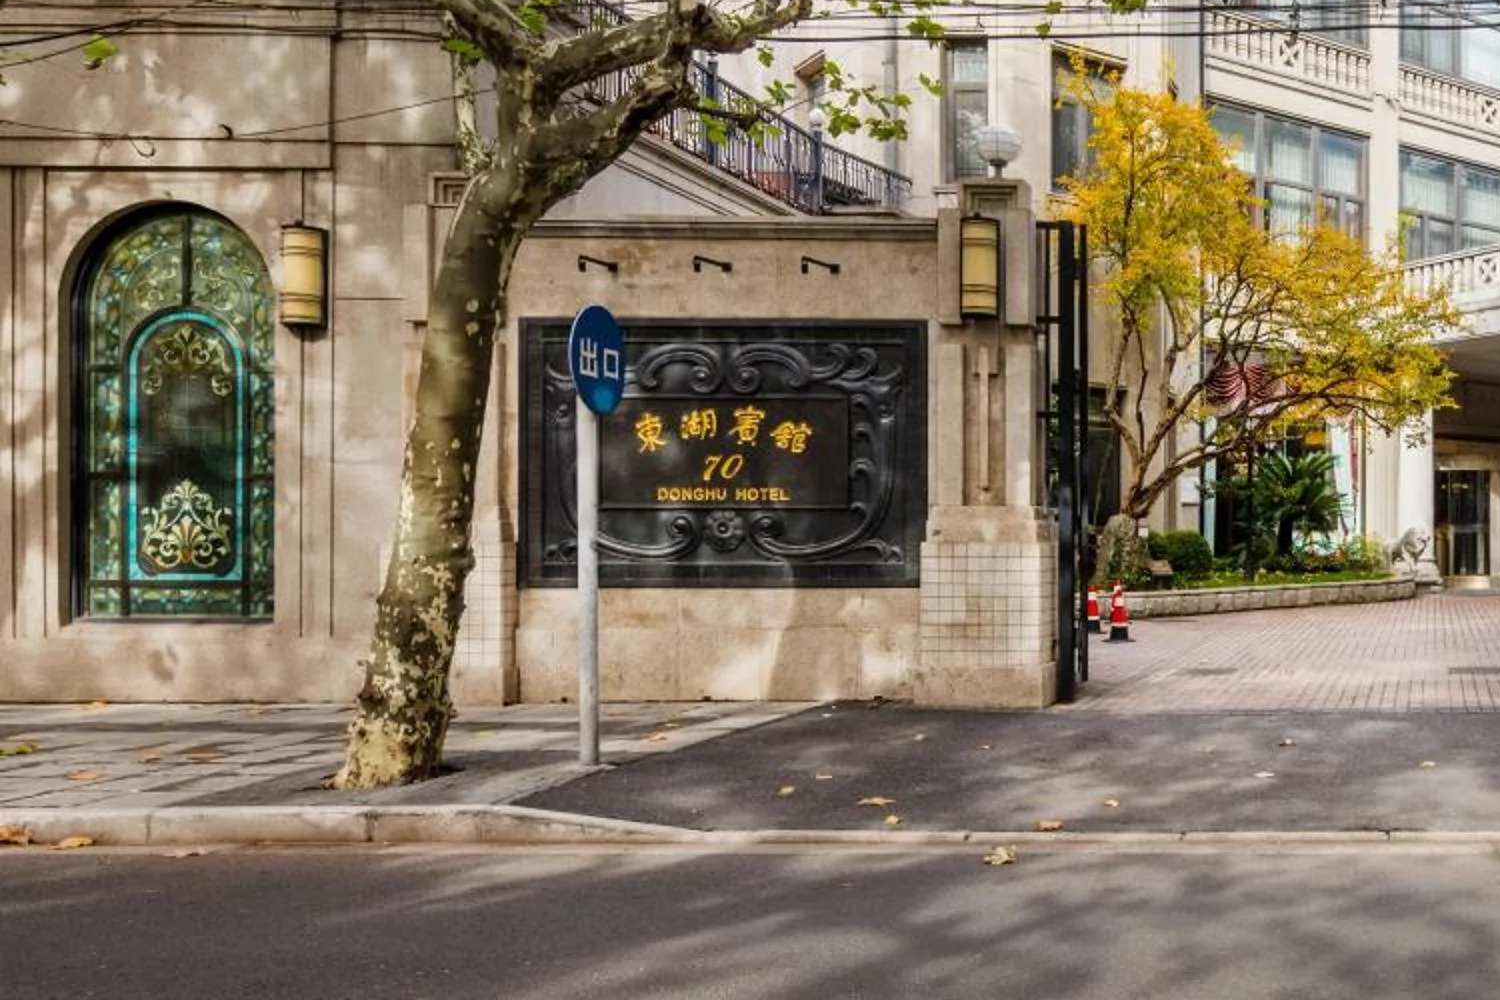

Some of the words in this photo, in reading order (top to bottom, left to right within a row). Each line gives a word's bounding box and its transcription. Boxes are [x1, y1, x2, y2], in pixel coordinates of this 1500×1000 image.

[580, 337, 620, 379] 出口
[703, 453, 744, 481] 70
[657, 487, 727, 501] DONGHU
[735, 487, 791, 501] HOTEL
